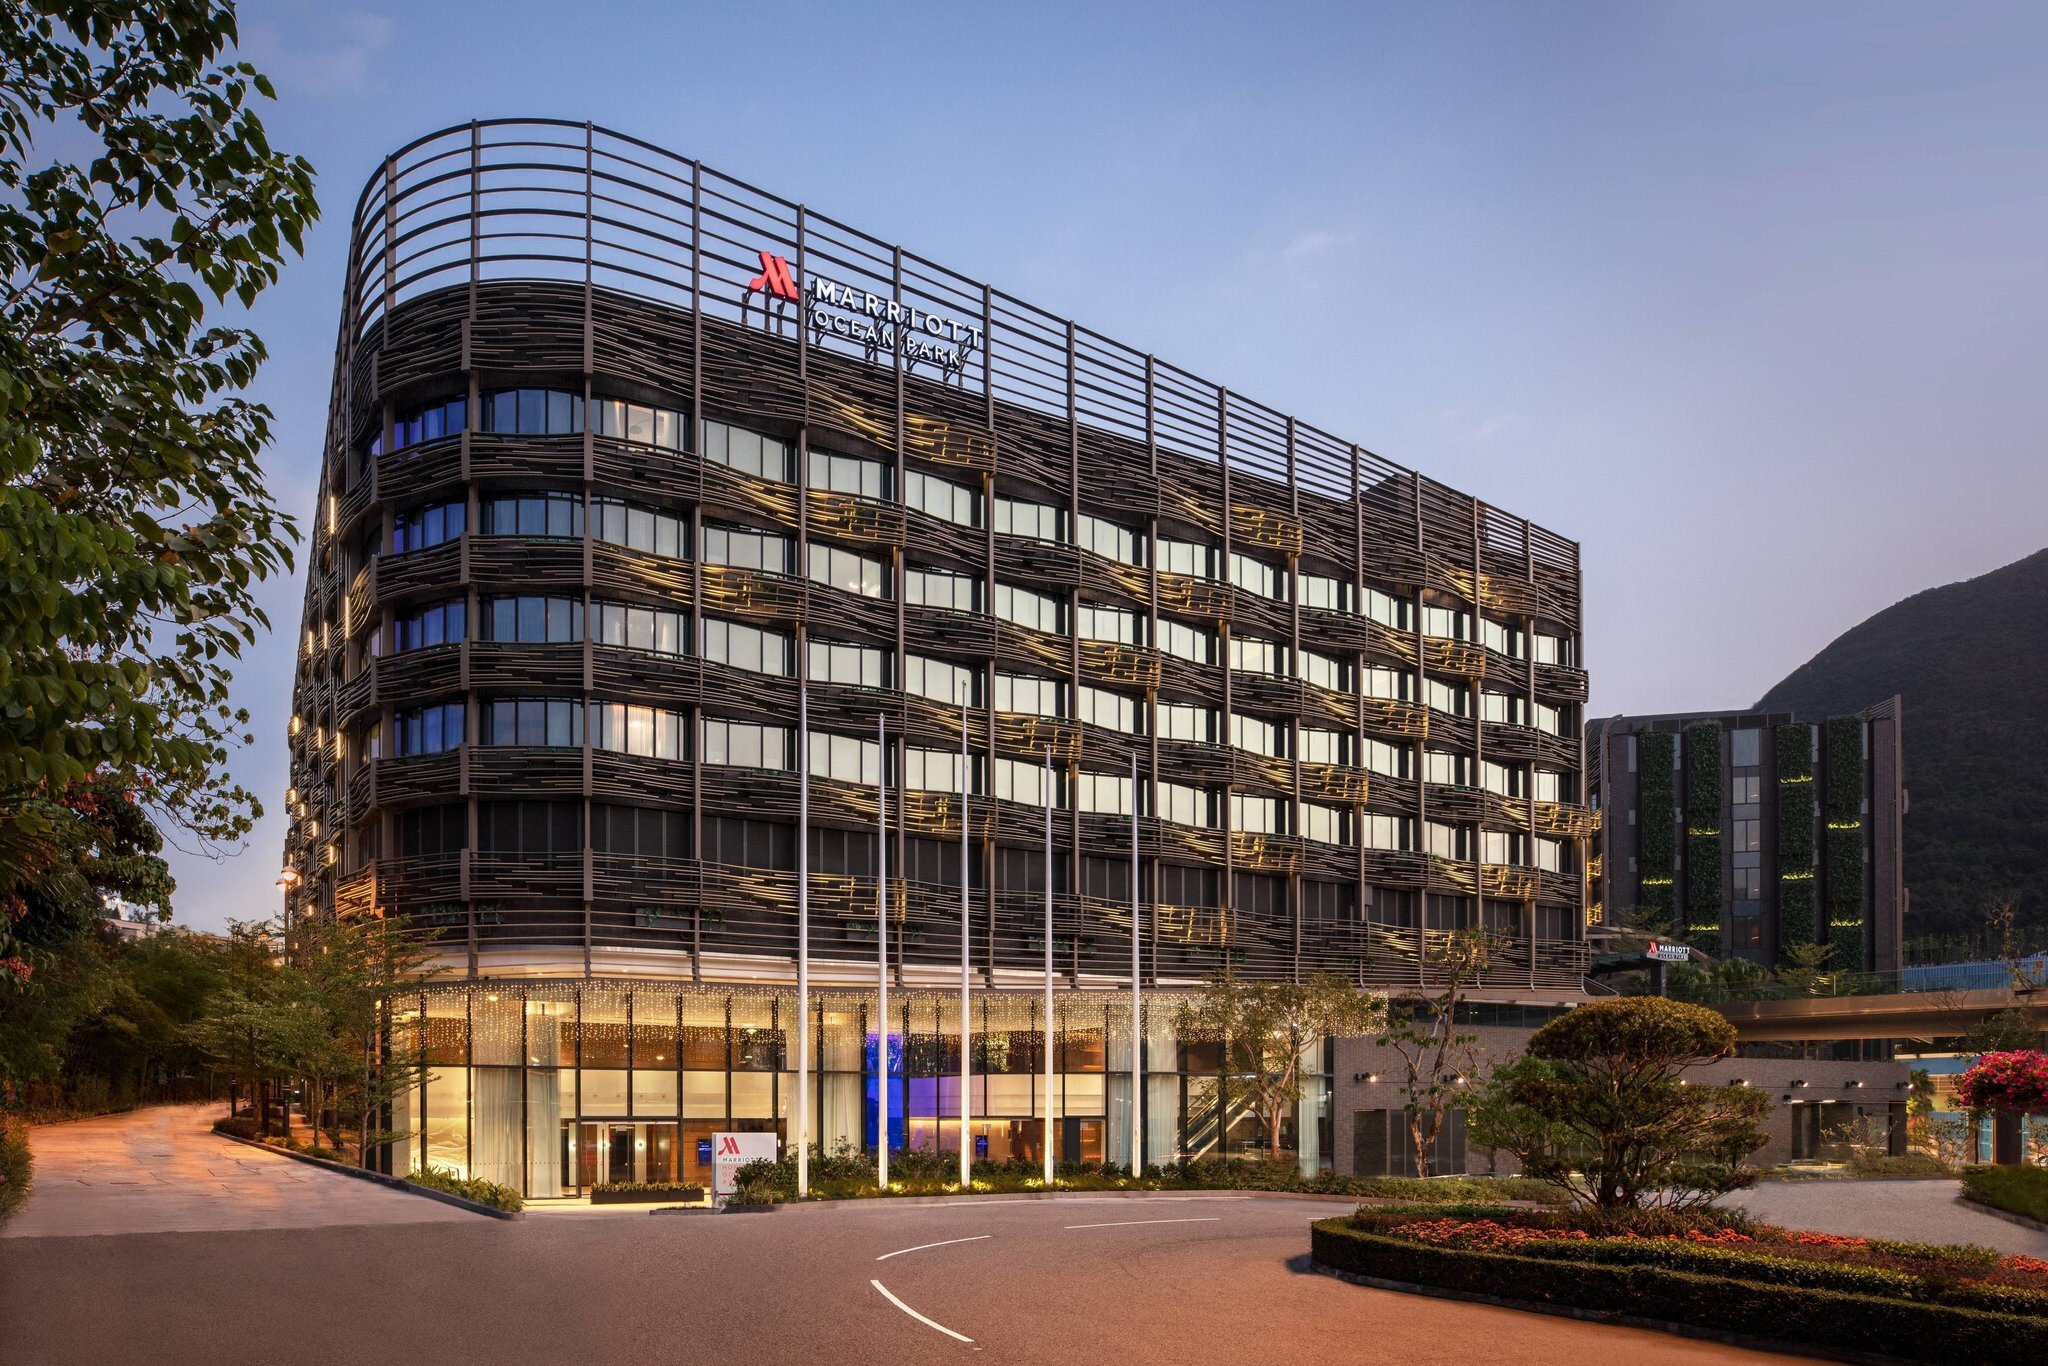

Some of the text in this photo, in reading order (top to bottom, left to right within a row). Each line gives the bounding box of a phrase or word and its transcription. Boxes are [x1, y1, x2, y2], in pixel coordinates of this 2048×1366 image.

[815, 277, 983, 347] MARRIOTT
[815, 310, 960, 366] OCEAN PARK
[1659, 945, 1690, 954] MARRIOTT
